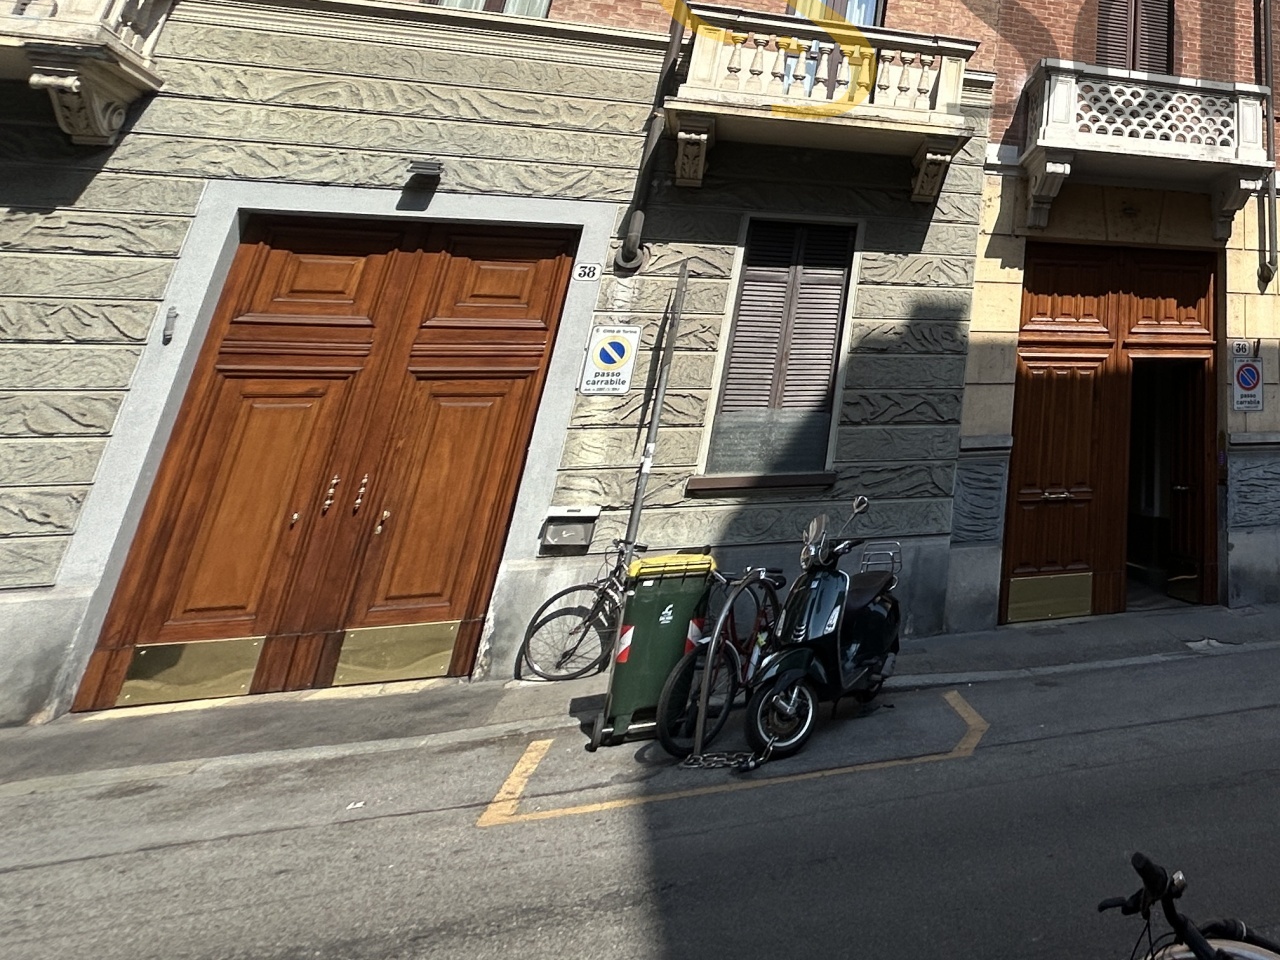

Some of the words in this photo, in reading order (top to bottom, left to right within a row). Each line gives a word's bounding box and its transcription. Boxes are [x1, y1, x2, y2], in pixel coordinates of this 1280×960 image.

[577, 265, 597, 279] 38
[1235, 343, 1247, 354] 36
[594, 371, 621, 379] passo
[585, 378, 627, 386] carrabile
